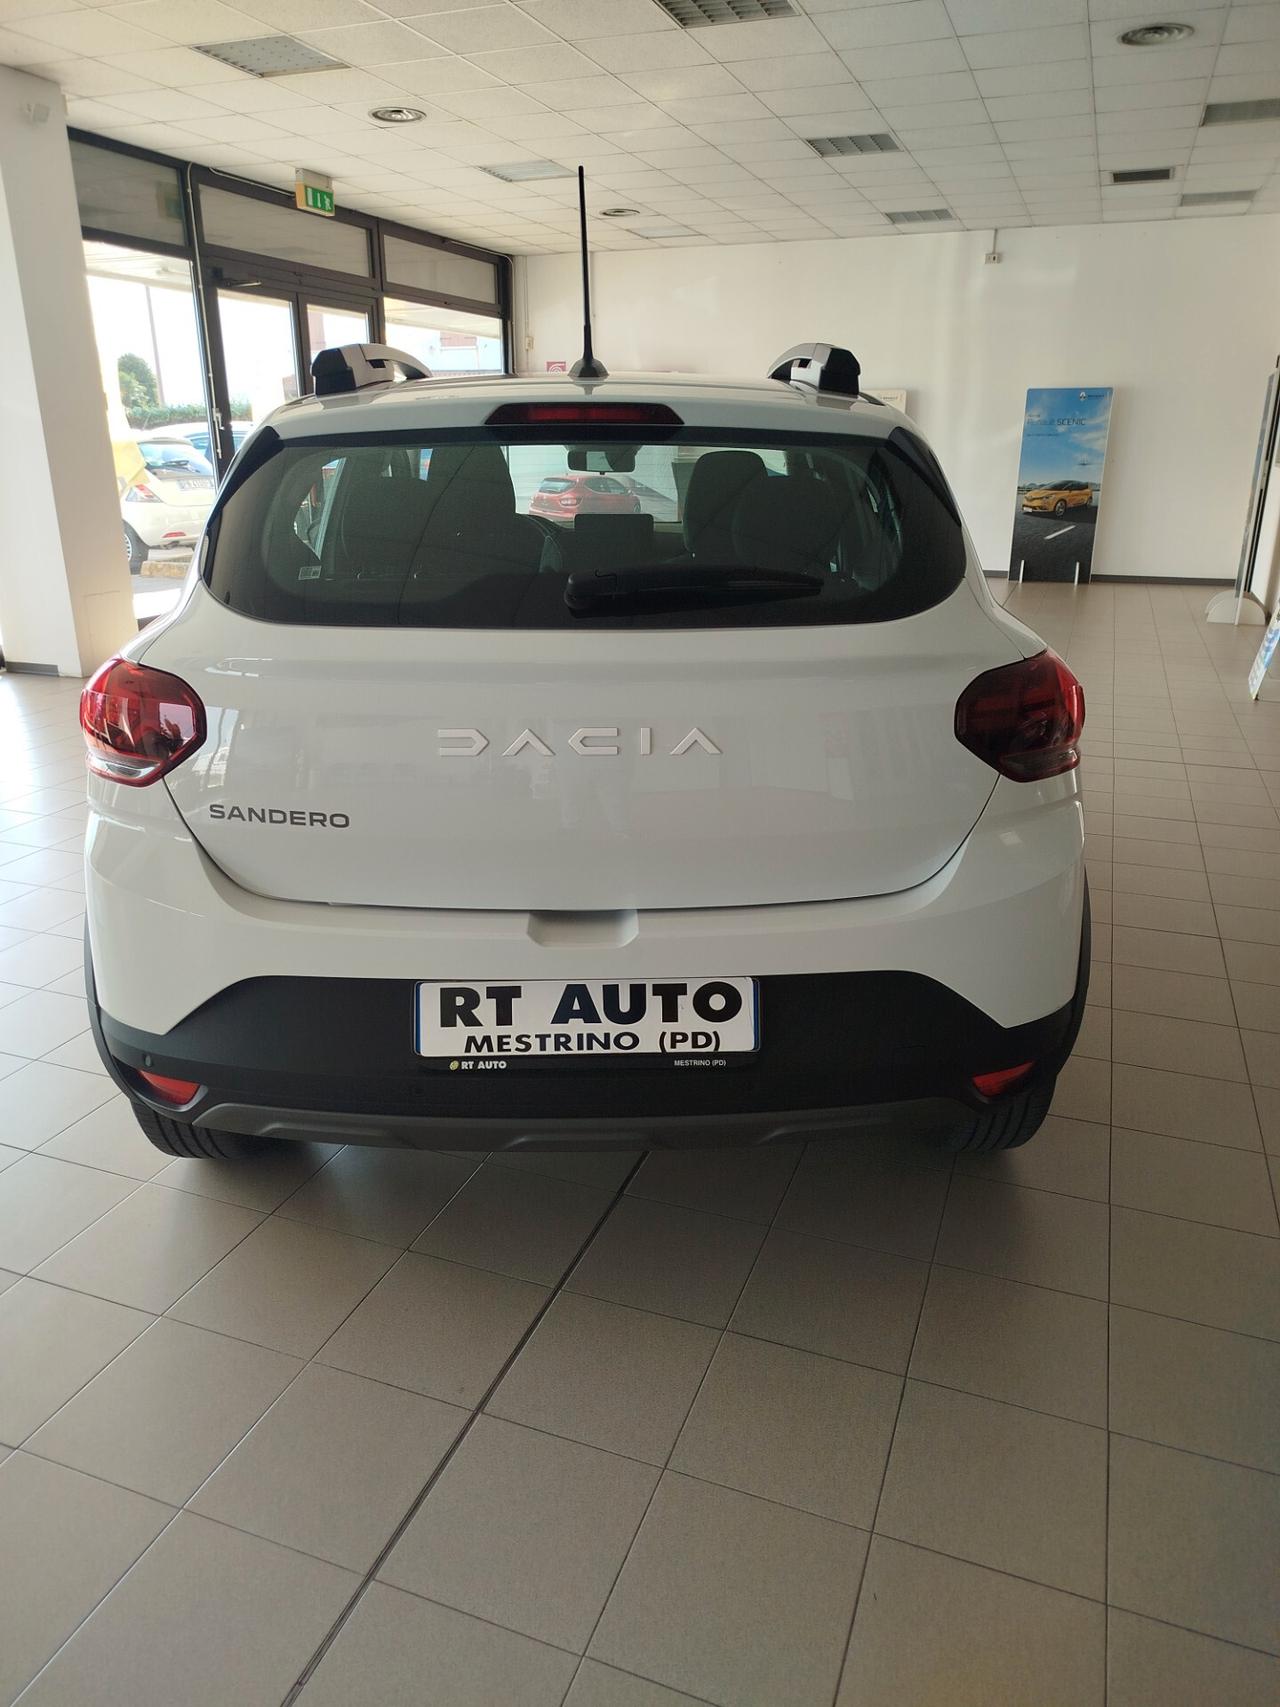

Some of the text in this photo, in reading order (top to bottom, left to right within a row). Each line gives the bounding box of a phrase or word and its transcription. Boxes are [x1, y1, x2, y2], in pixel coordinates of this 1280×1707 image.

[437, 727, 723, 756] DACIA
[209, 804, 350, 828] SANDERO
[439, 981, 743, 1028] RT AUTO
[464, 1030, 721, 1054] MESTRINO (PD)
[461, 1060, 507, 1069] RT AUTO
[674, 1058, 727, 1067] MESTRINO (PD)
